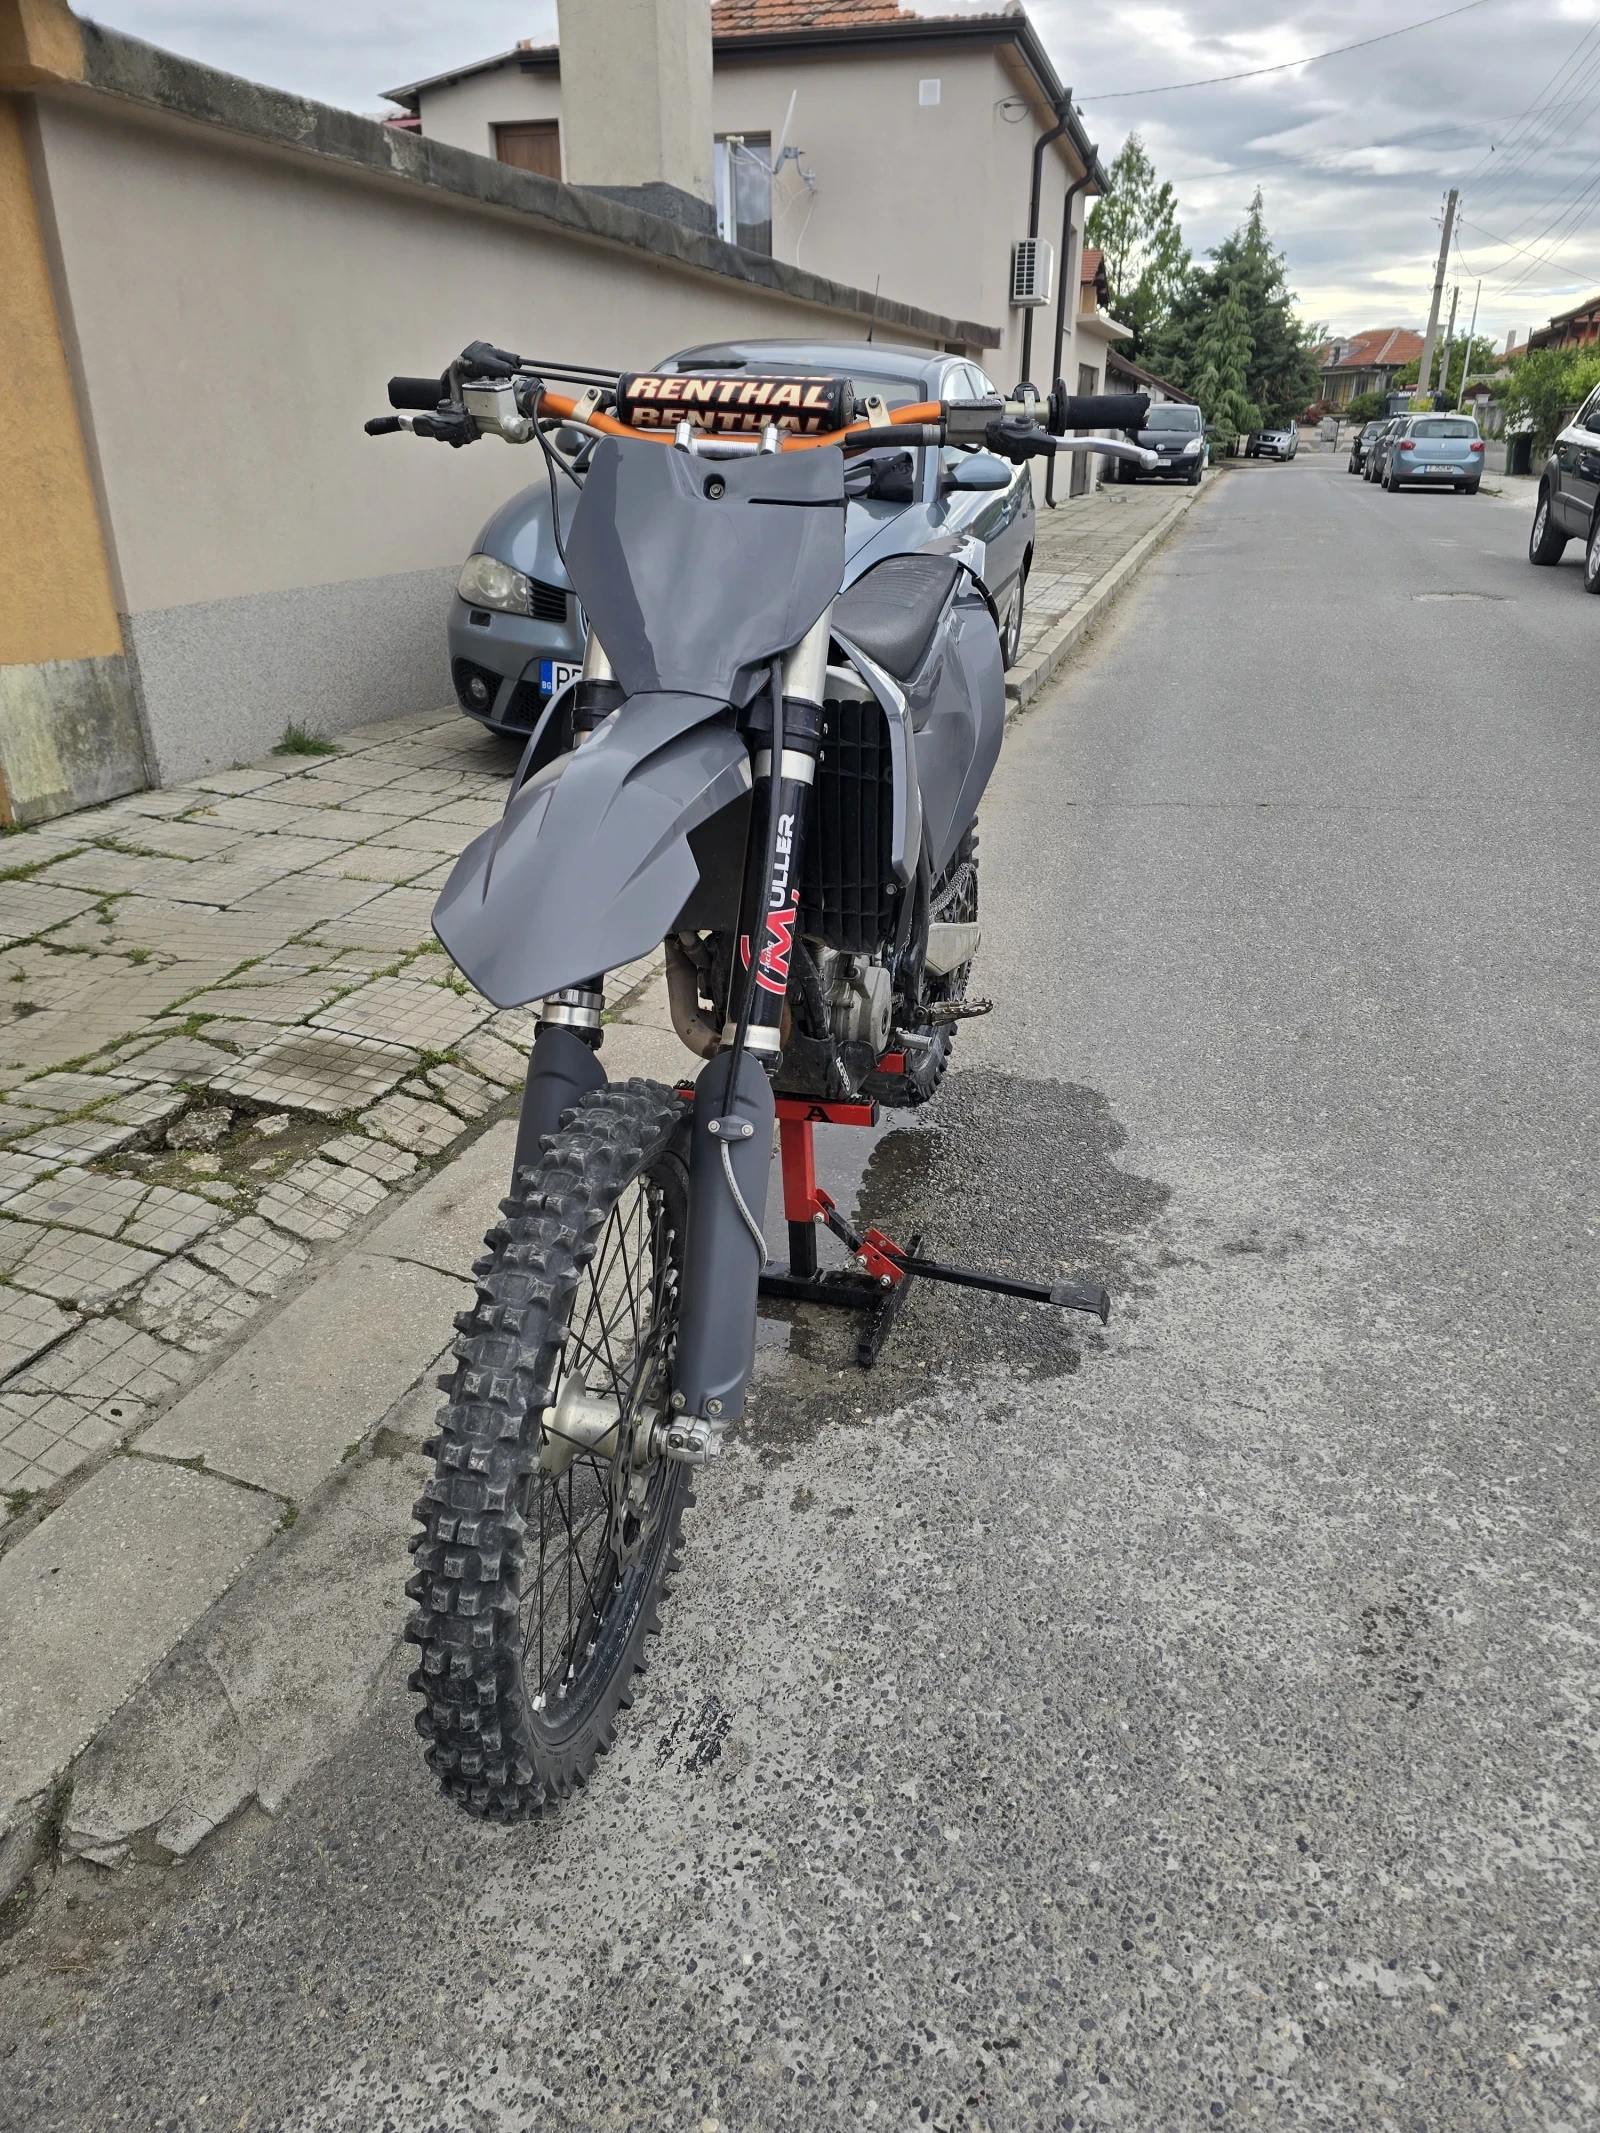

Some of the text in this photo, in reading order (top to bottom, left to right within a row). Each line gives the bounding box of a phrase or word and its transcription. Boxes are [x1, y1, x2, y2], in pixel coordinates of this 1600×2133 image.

[626, 377, 830, 408] RENTHAL
[631, 406, 827, 432] RENTHAL
[541, 681, 552, 690] BG
[763, 940, 775, 973] racing
[804, 1105, 834, 1123] A
